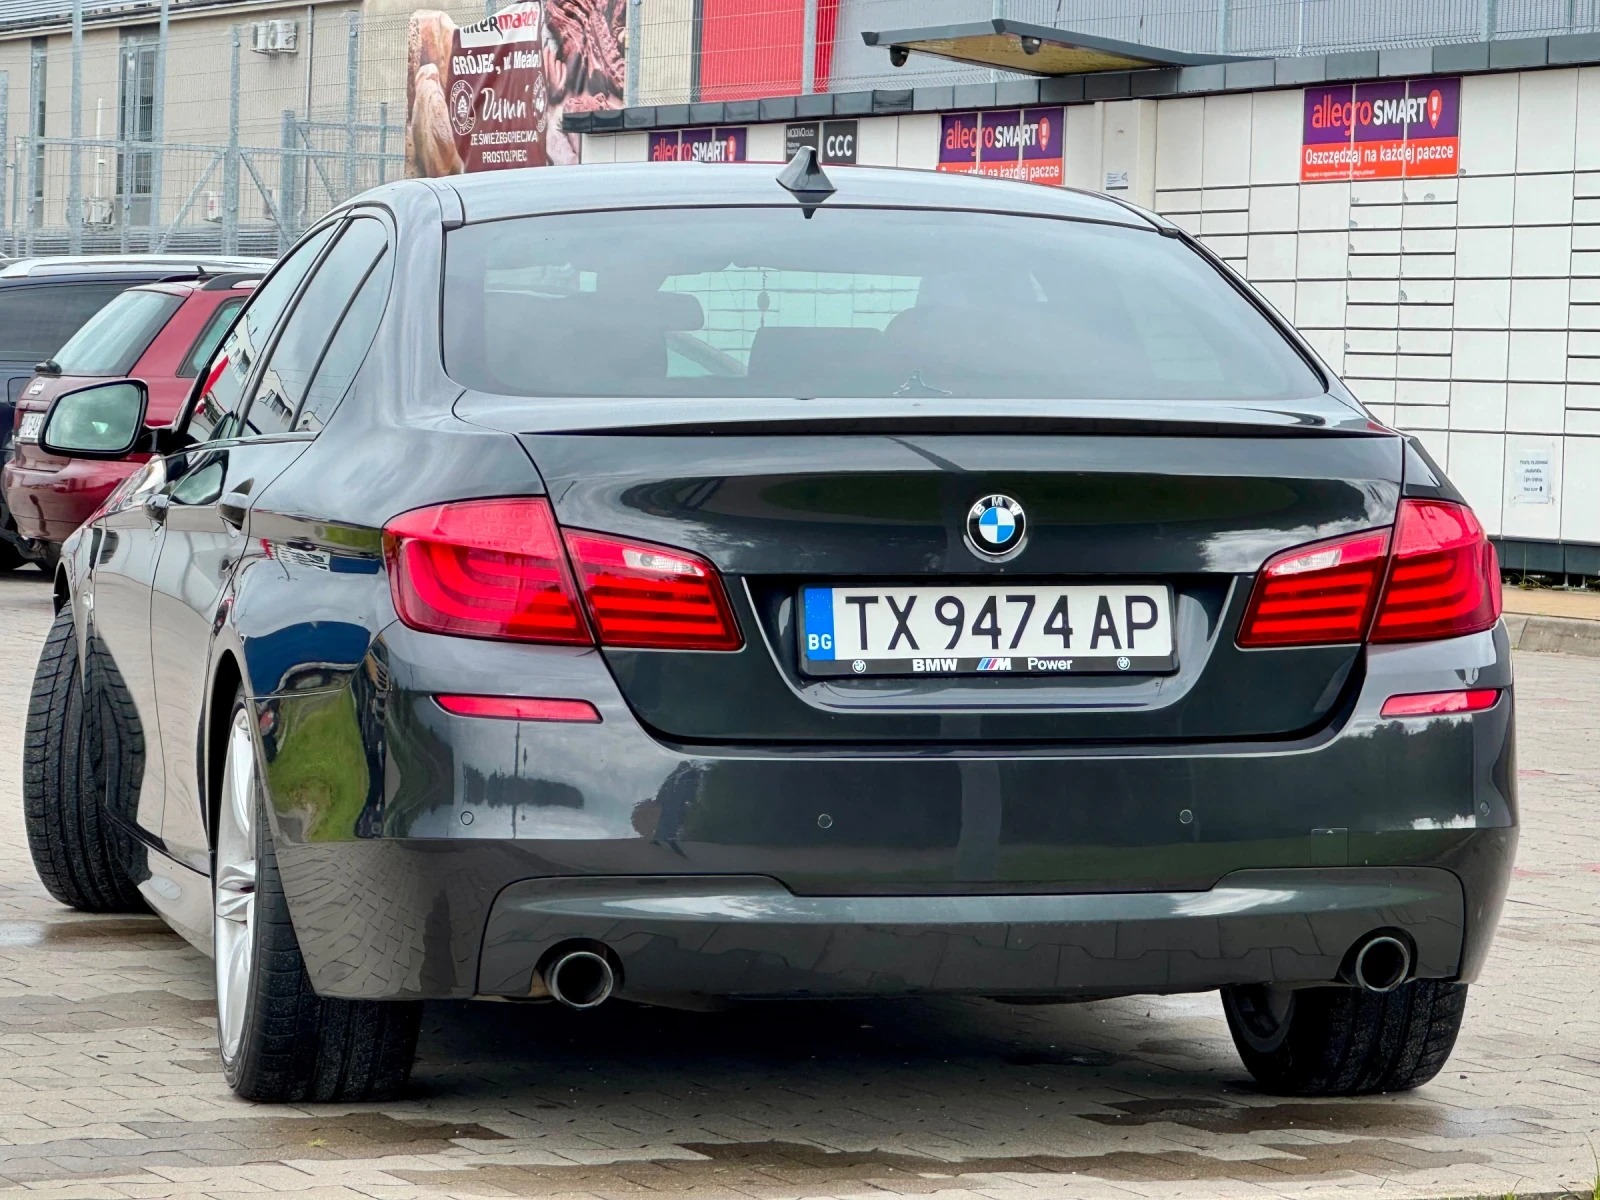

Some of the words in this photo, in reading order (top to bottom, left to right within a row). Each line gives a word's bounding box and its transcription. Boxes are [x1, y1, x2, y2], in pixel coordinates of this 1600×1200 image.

[1312, 94, 1372, 136] allegro
[826, 134, 853, 157] CCC
[946, 120, 994, 156] allegro
[1364, 149, 1377, 162] na
[1417, 145, 1454, 165] paczce
[1030, 165, 1060, 181] paczce
[974, 496, 1022, 517] BMW
[808, 634, 832, 651] BG
[845, 595, 920, 650] TX
[934, 595, 1074, 650] 9474
[1089, 594, 1159, 650] AP
[912, 658, 958, 672] BMW
[1027, 657, 1073, 671] Power
